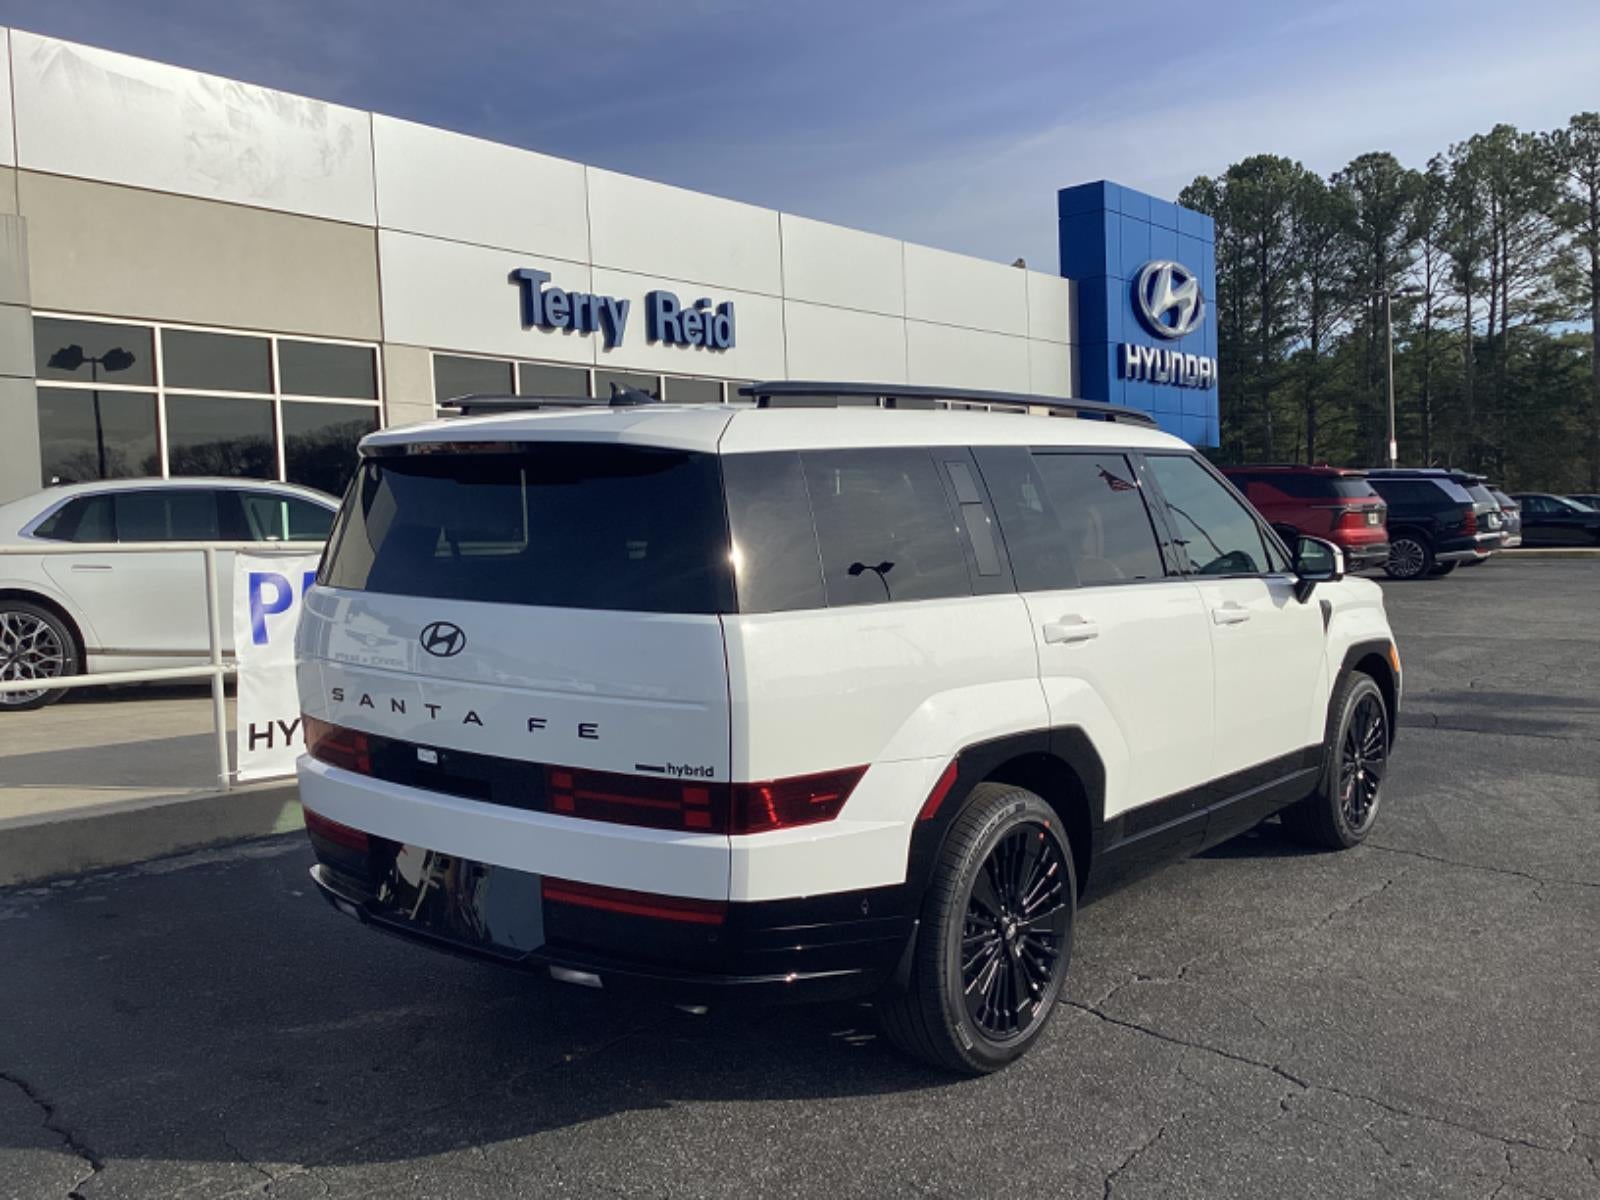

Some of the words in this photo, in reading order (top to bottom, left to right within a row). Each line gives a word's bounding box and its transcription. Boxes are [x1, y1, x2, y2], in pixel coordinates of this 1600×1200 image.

[508, 268, 630, 353] Terry
[644, 289, 735, 350] Reid
[1118, 343, 1217, 390] HYUNDAI
[248, 571, 316, 645] P
[248, 717, 306, 751] HY
[331, 687, 484, 727] SANTA
[527, 717, 600, 740] FE
[667, 762, 715, 779] hybrid
